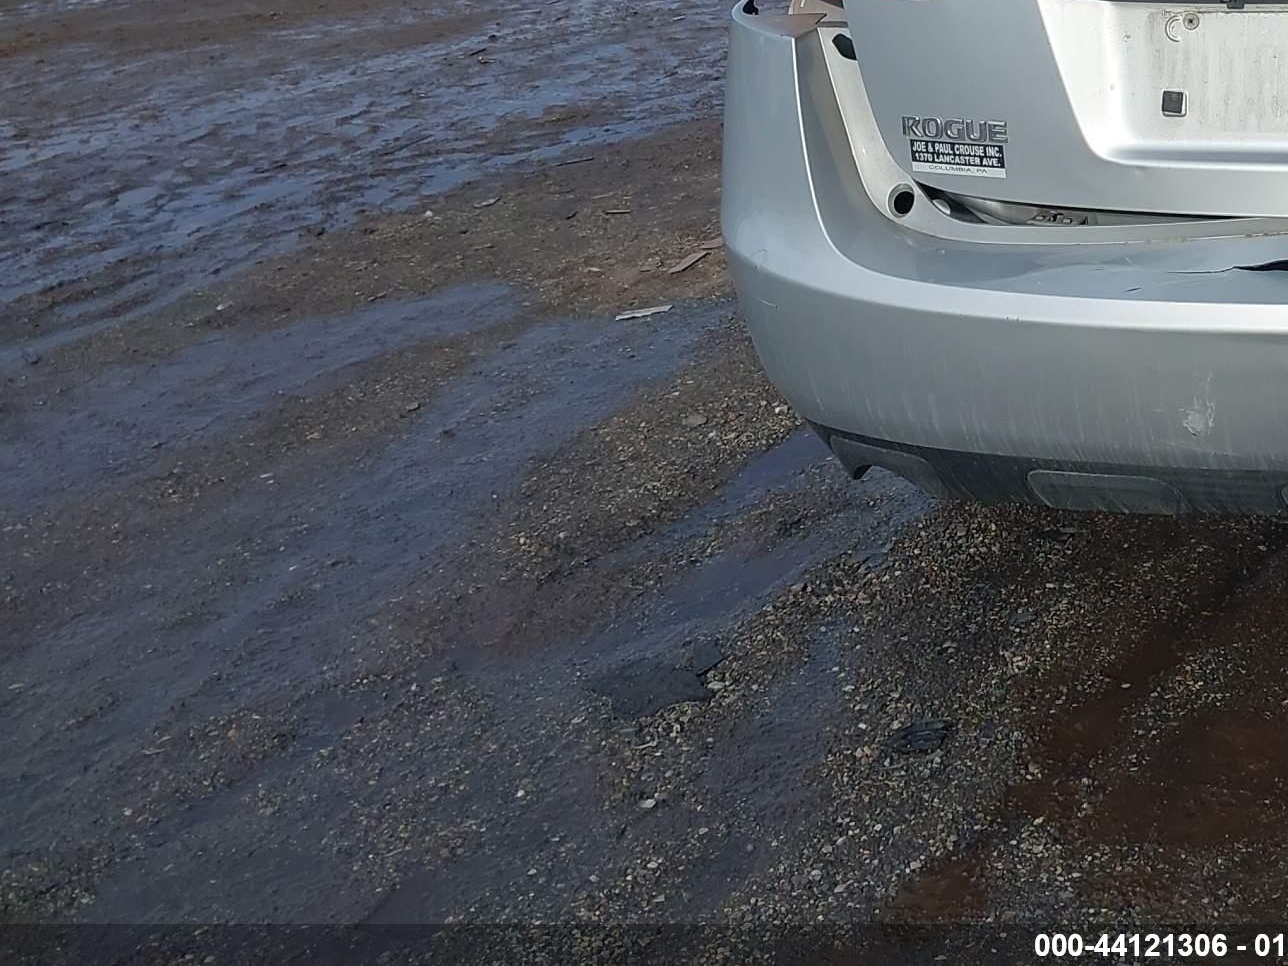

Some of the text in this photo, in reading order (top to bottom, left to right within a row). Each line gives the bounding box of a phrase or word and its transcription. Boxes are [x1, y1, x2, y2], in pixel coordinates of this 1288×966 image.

[902, 115, 1009, 144] ROGUE
[912, 141, 1003, 158] JOE & PAUL CROUSE INC.
[914, 152, 1002, 167] 1370 LANCASTER AVE.
